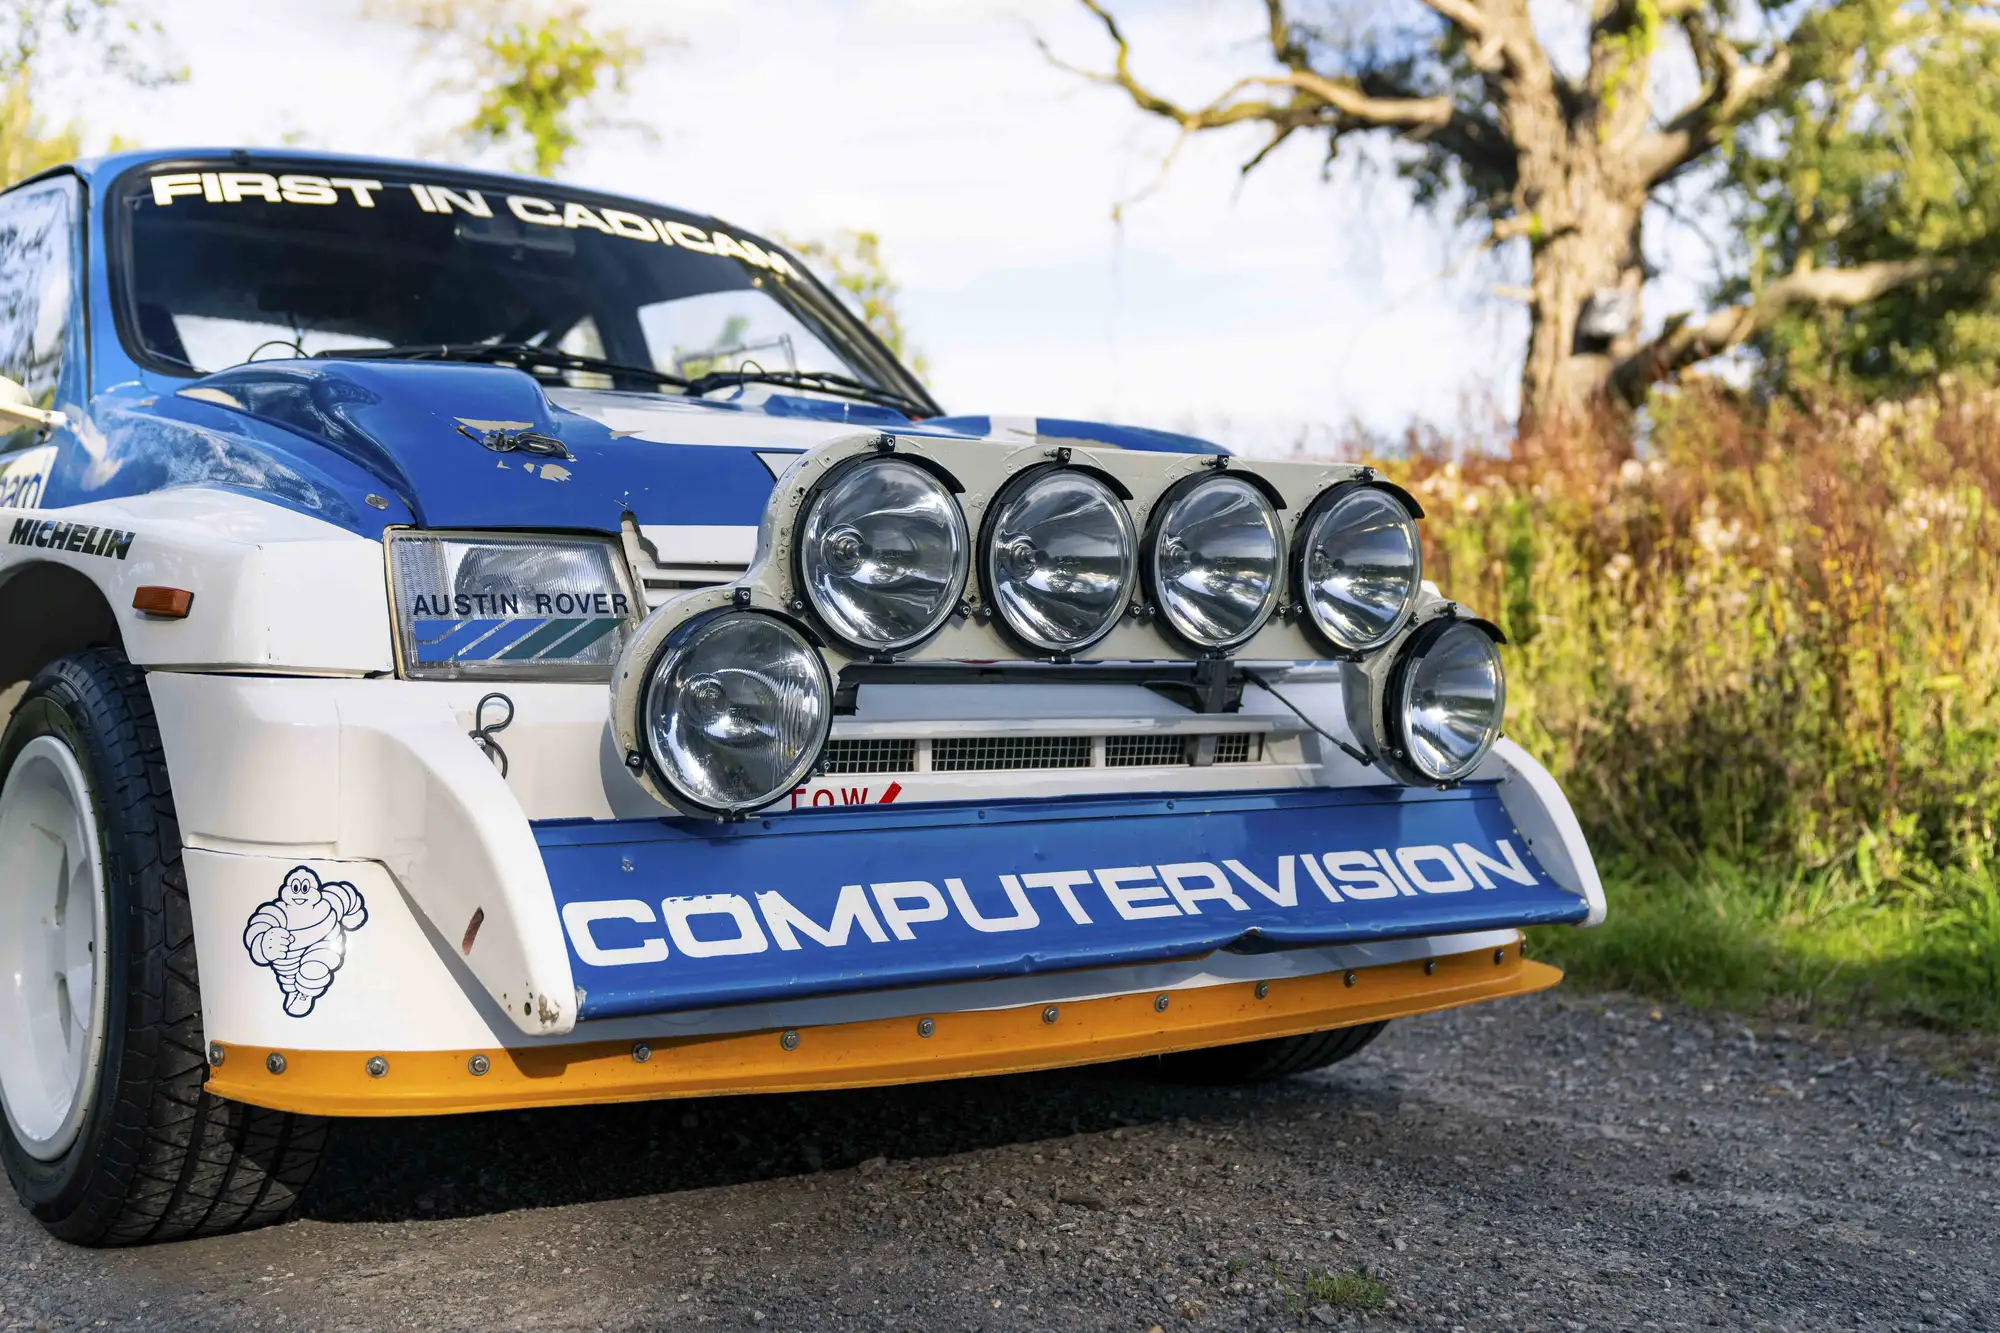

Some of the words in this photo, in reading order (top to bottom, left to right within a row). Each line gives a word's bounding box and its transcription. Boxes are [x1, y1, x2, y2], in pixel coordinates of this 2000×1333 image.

[150, 172, 384, 208] FIRST
[409, 183, 494, 218] IN
[8, 517, 136, 560] MICHELIN
[413, 593, 519, 616] AUSTIN
[536, 593, 629, 615] ROVER
[789, 787, 868, 811] TOW
[562, 838, 1540, 967] COMPUTERVISION
